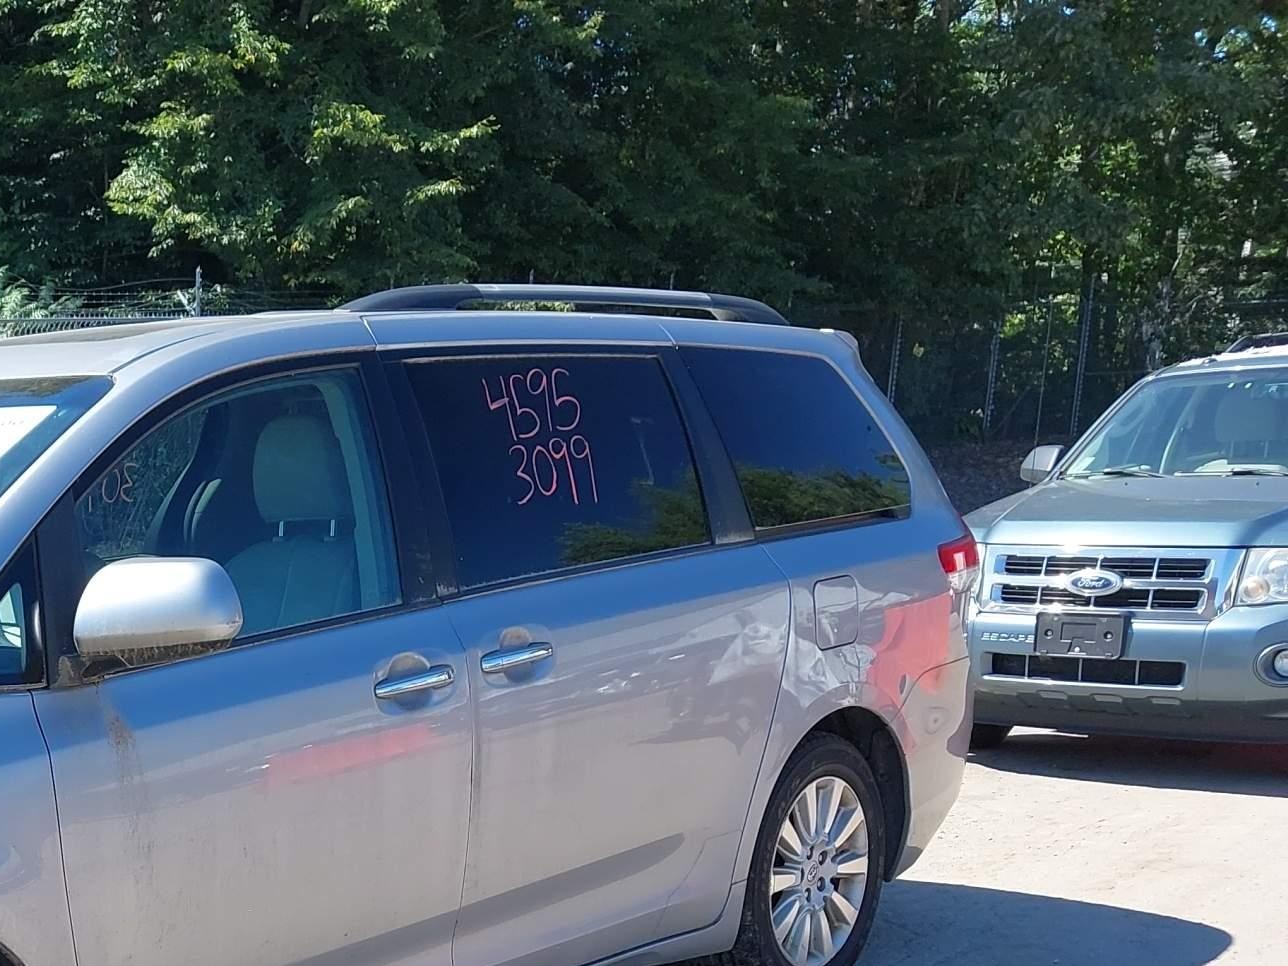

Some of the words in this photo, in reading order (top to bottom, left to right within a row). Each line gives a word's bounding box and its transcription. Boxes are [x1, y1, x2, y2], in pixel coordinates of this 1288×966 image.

[481, 367, 581, 442] 4595
[508, 434, 599, 505] 3099
[1076, 575, 1107, 589] Ford
